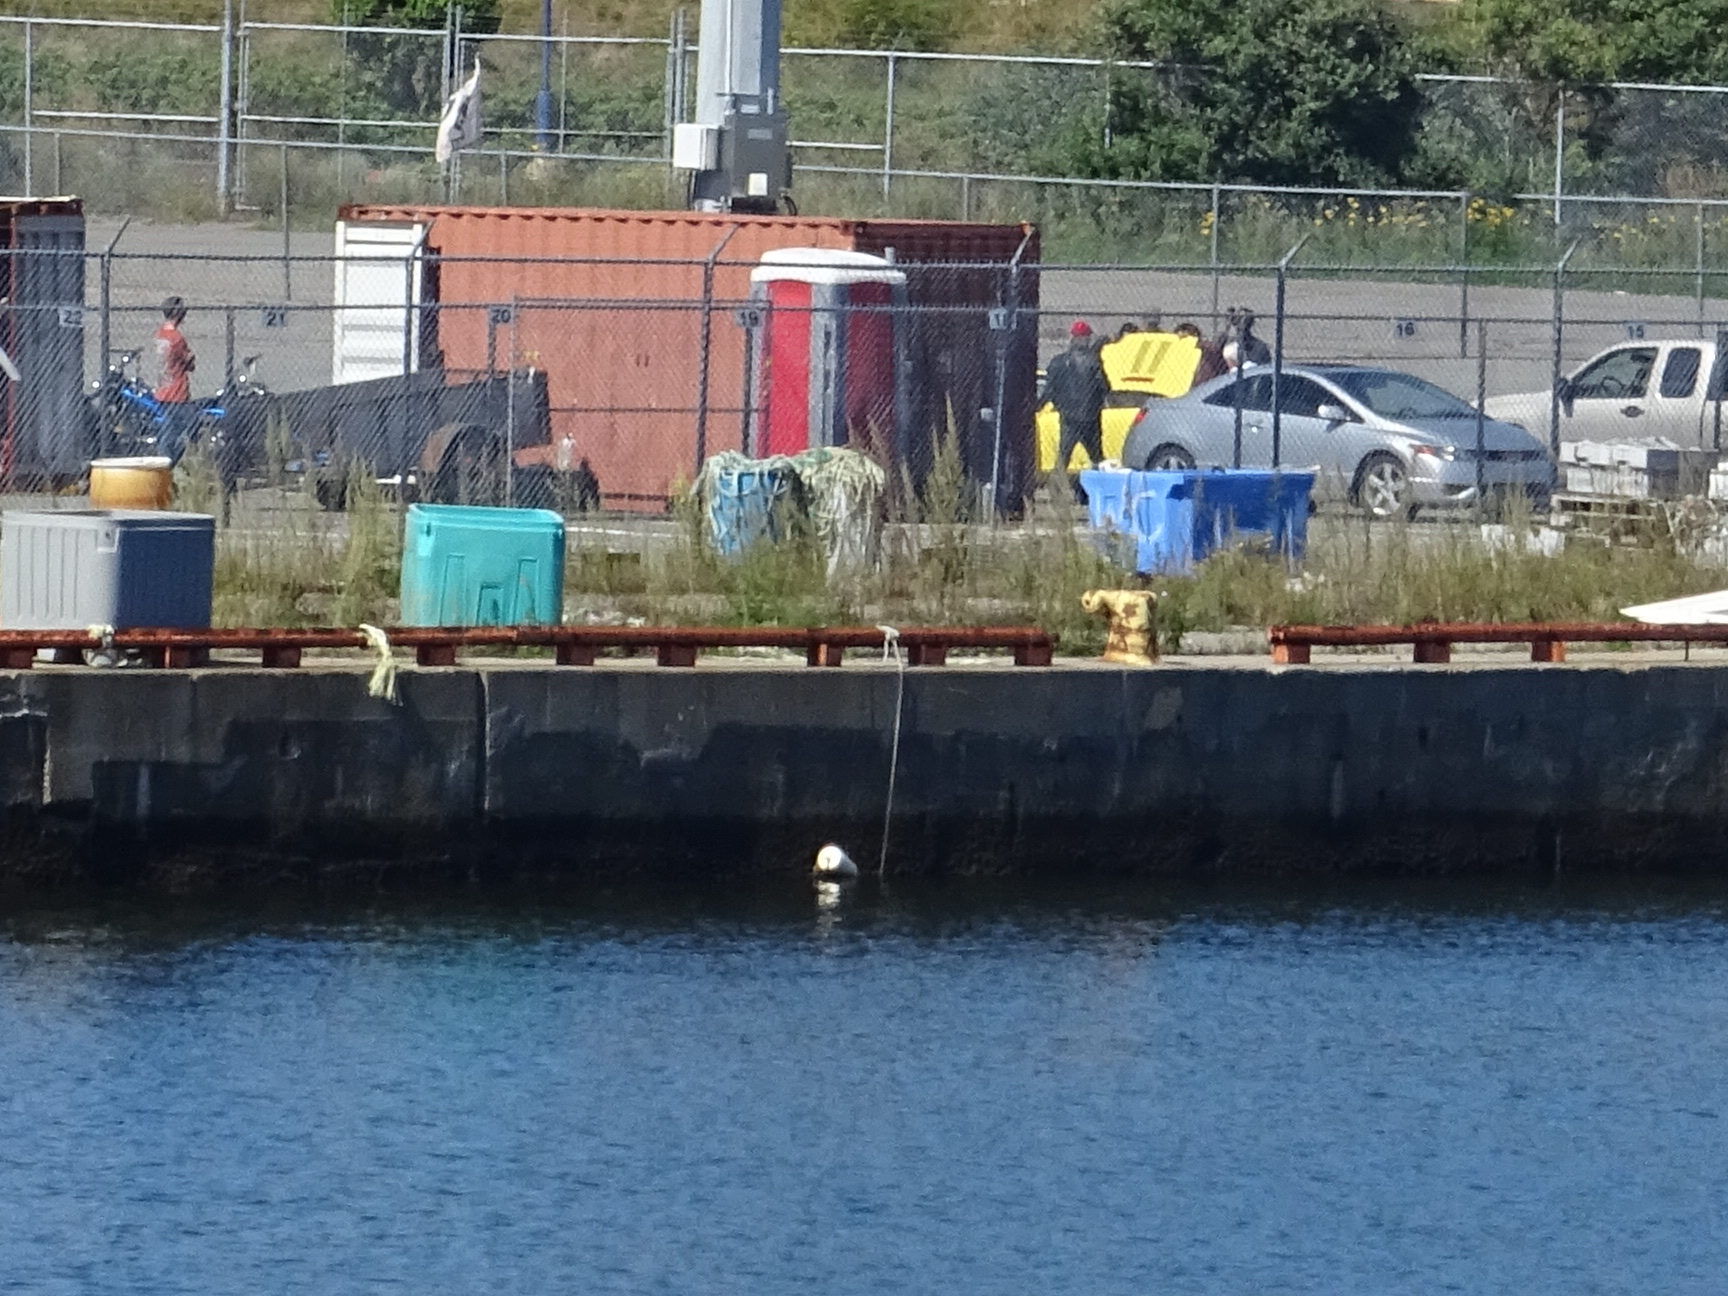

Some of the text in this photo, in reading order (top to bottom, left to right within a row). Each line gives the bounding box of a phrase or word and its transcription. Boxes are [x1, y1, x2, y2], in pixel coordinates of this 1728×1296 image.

[266, 311, 286, 327] 21
[490, 309, 512, 324] 20
[1396, 322, 1415, 336] 16
